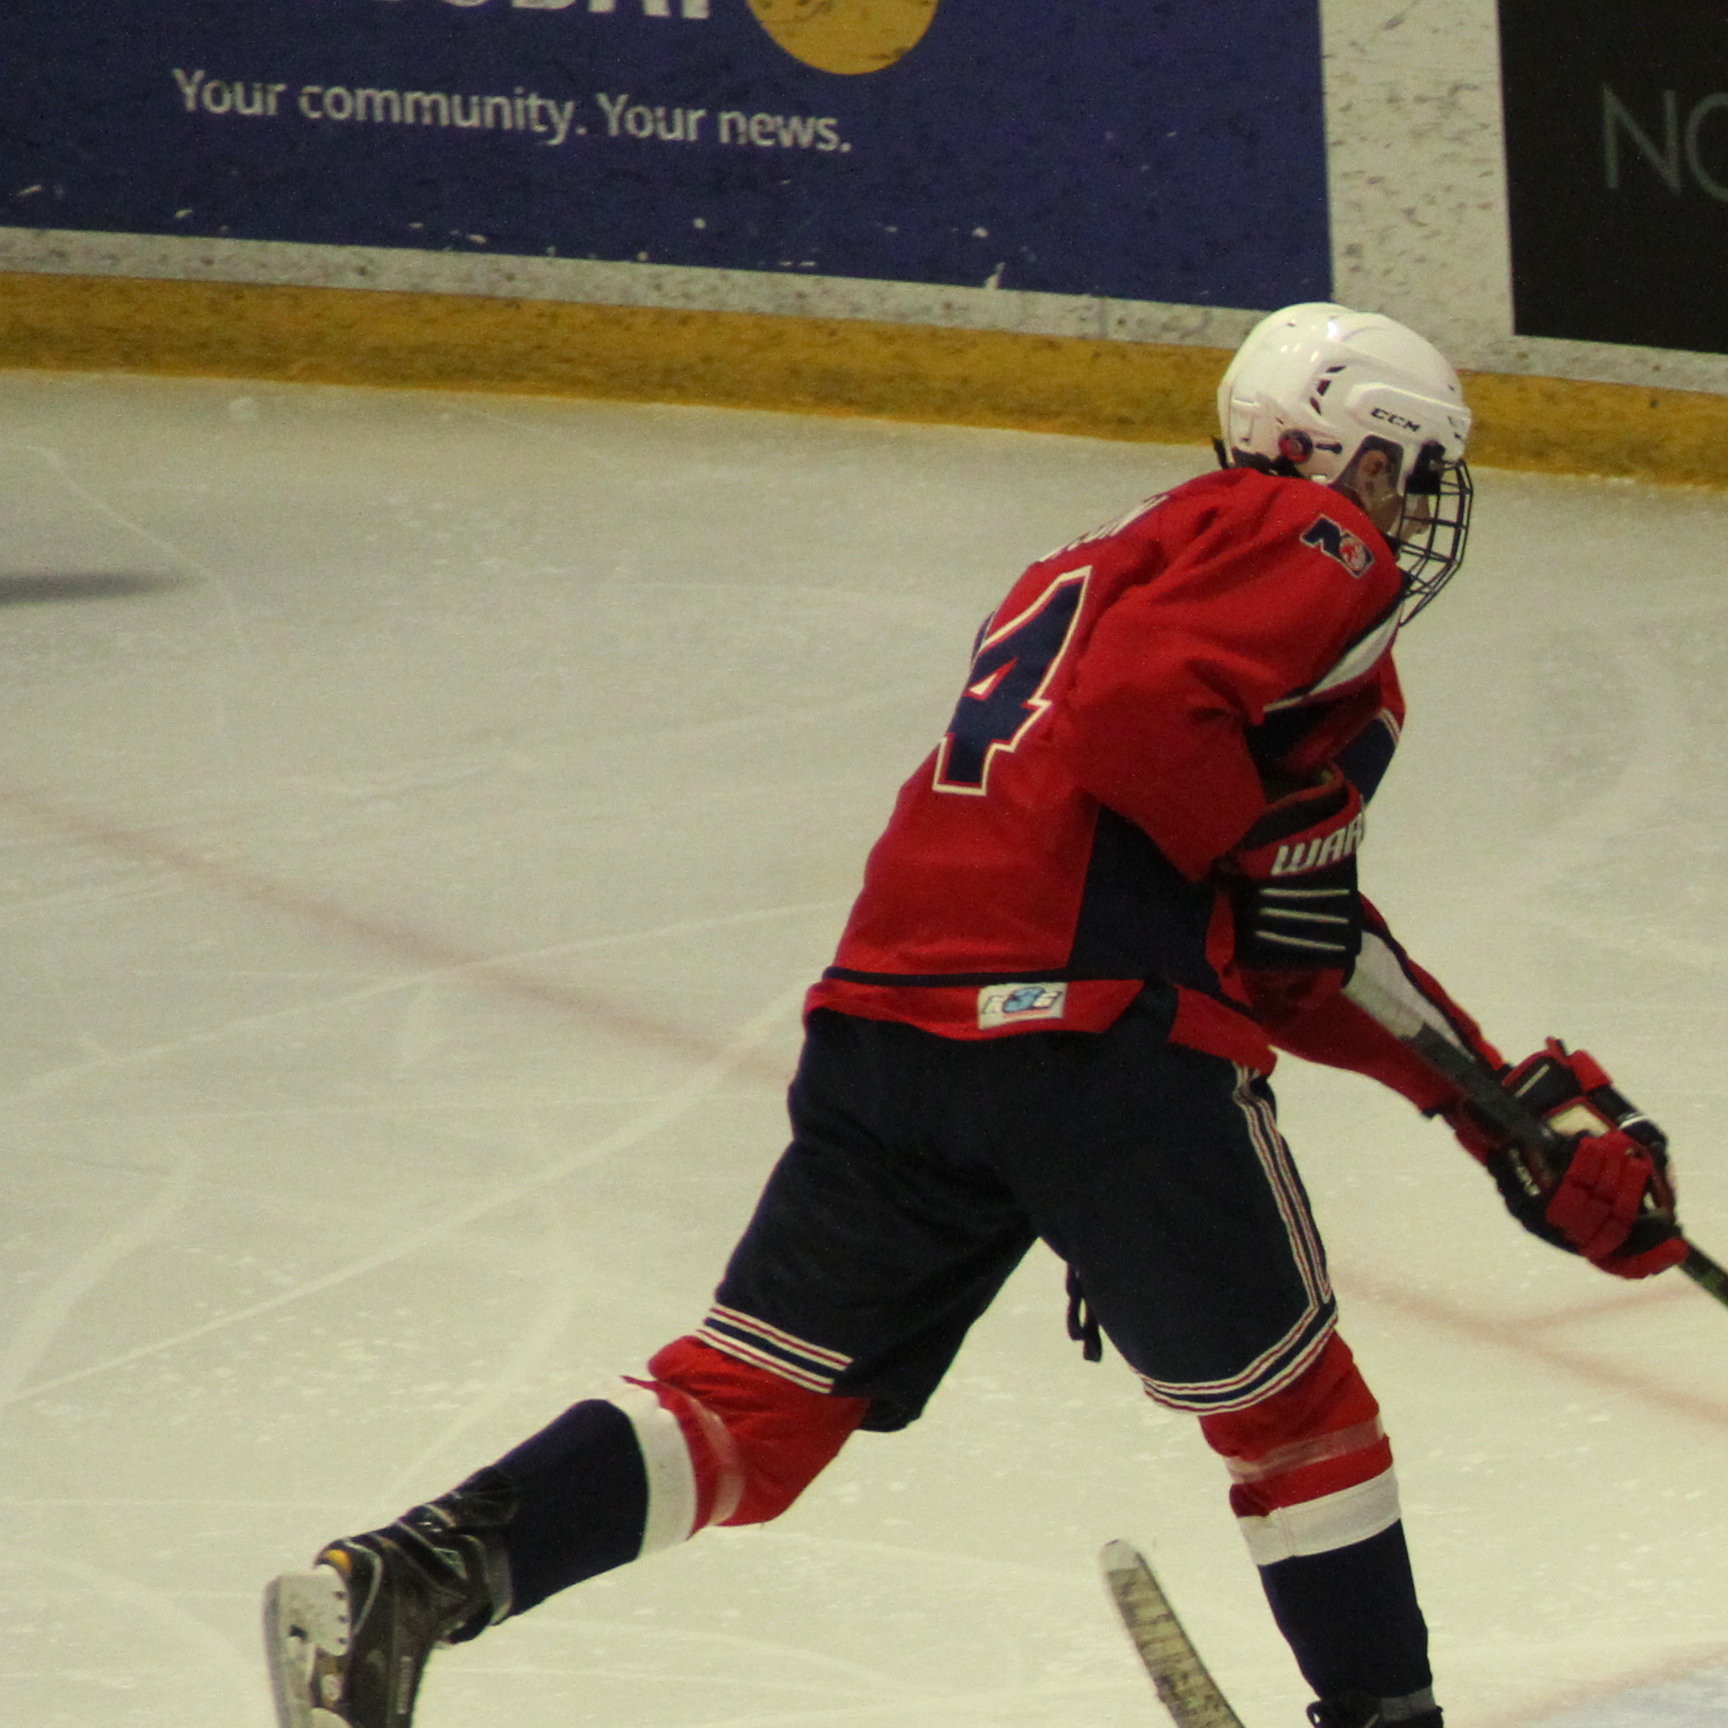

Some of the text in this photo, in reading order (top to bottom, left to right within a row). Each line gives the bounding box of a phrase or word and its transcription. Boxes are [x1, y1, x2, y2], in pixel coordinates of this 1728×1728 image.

[172, 67, 852, 152] Your community. Your news.
[1369, 406, 1422, 433] CCM
